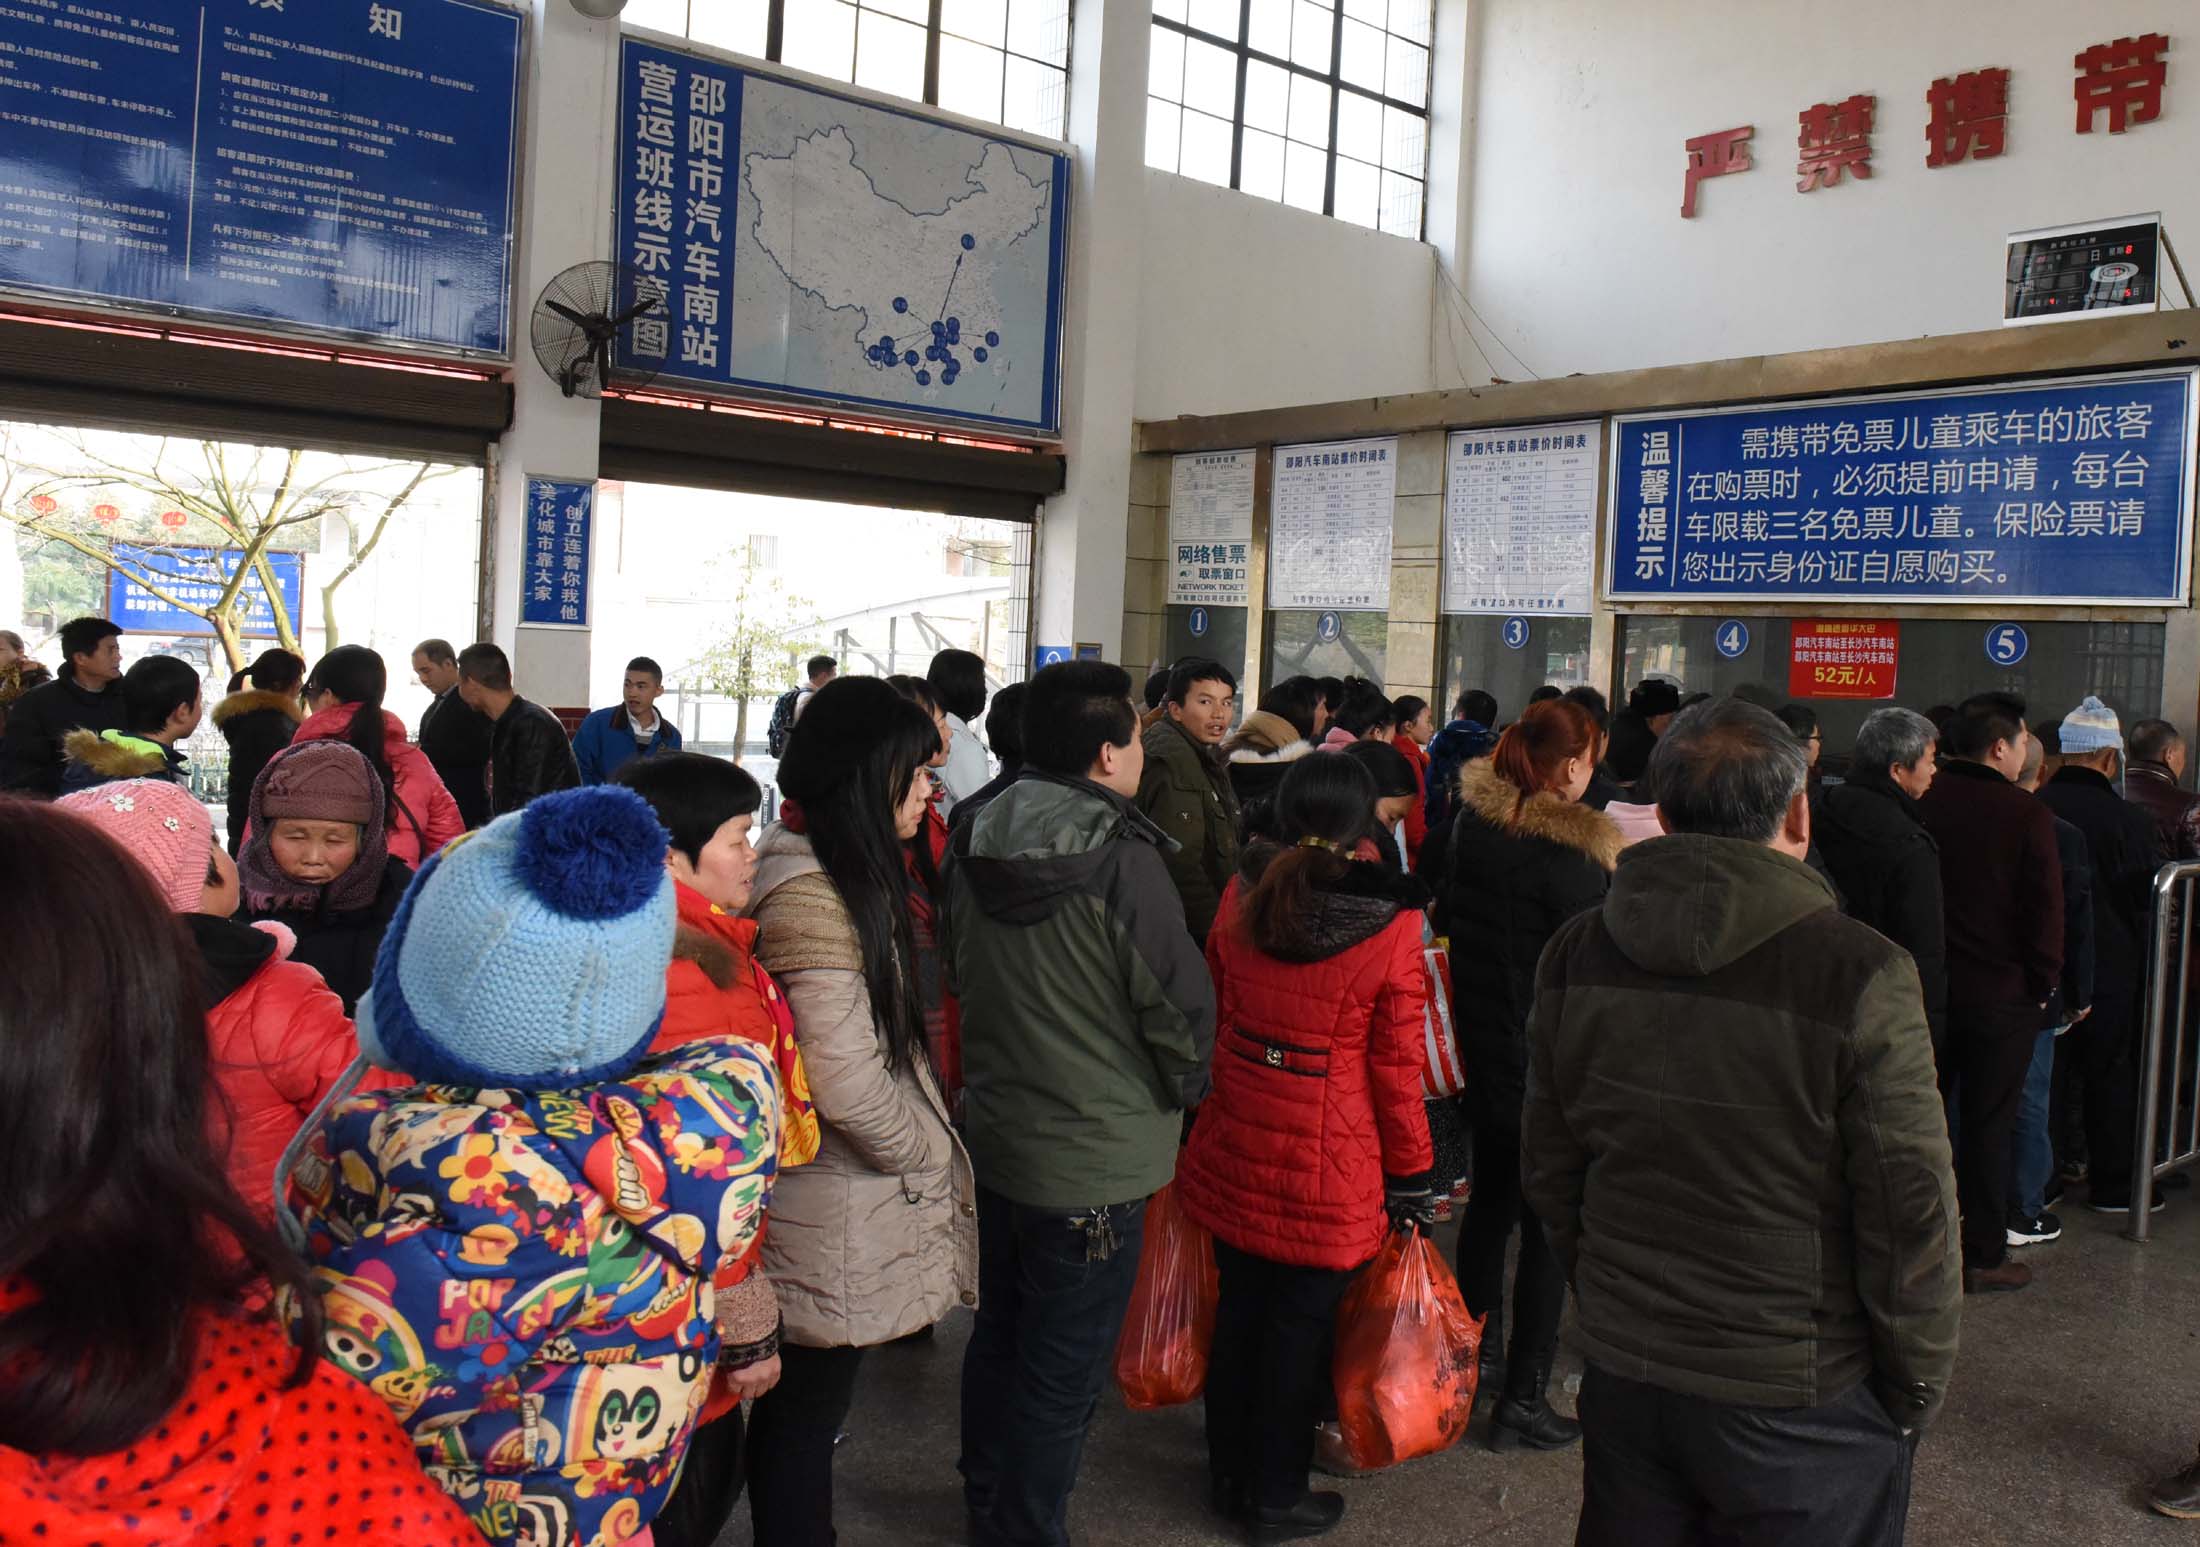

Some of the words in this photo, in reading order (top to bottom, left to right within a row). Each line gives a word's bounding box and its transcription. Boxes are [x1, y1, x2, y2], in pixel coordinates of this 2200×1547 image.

[368, 2, 402, 40] 知
[1681, 33, 2170, 218] 严禁携带
[631, 60, 677, 359] 营运班线示意图
[681, 73, 727, 368] 邵阳市汽车南站
[1464, 434, 1587, 457] 邵阳汽车南站票价时间表
[1741, 401, 2152, 460] 需携带免票儿童乘车的旅客
[1286, 449, 1387, 468] 邵阳汽车南站票价时间表
[1687, 450, 2149, 502] 在购票时，必须提前申请，每台
[1635, 431, 1671, 580] 温馨提示
[1684, 498, 2145, 543] 车限载三名免票儿童。保险票请
[534, 484, 558, 601] 美化城市靠大家
[1178, 545, 1246, 564] 网络售票
[560, 505, 584, 620] 创卫连着你我他
[1199, 568, 1245, 580] 取票窗口
[1682, 549, 2007, 584] 您出示身份证自愿购买。
[1325, 616, 1334, 636] 2
[1508, 620, 1522, 644] 3
[1723, 626, 1740, 651] 4
[1795, 637, 1894, 650] 邵阳汽车南站至长沙汽车南站
[1997, 629, 2016, 658] 5
[1815, 666, 1876, 685] 52元/人
